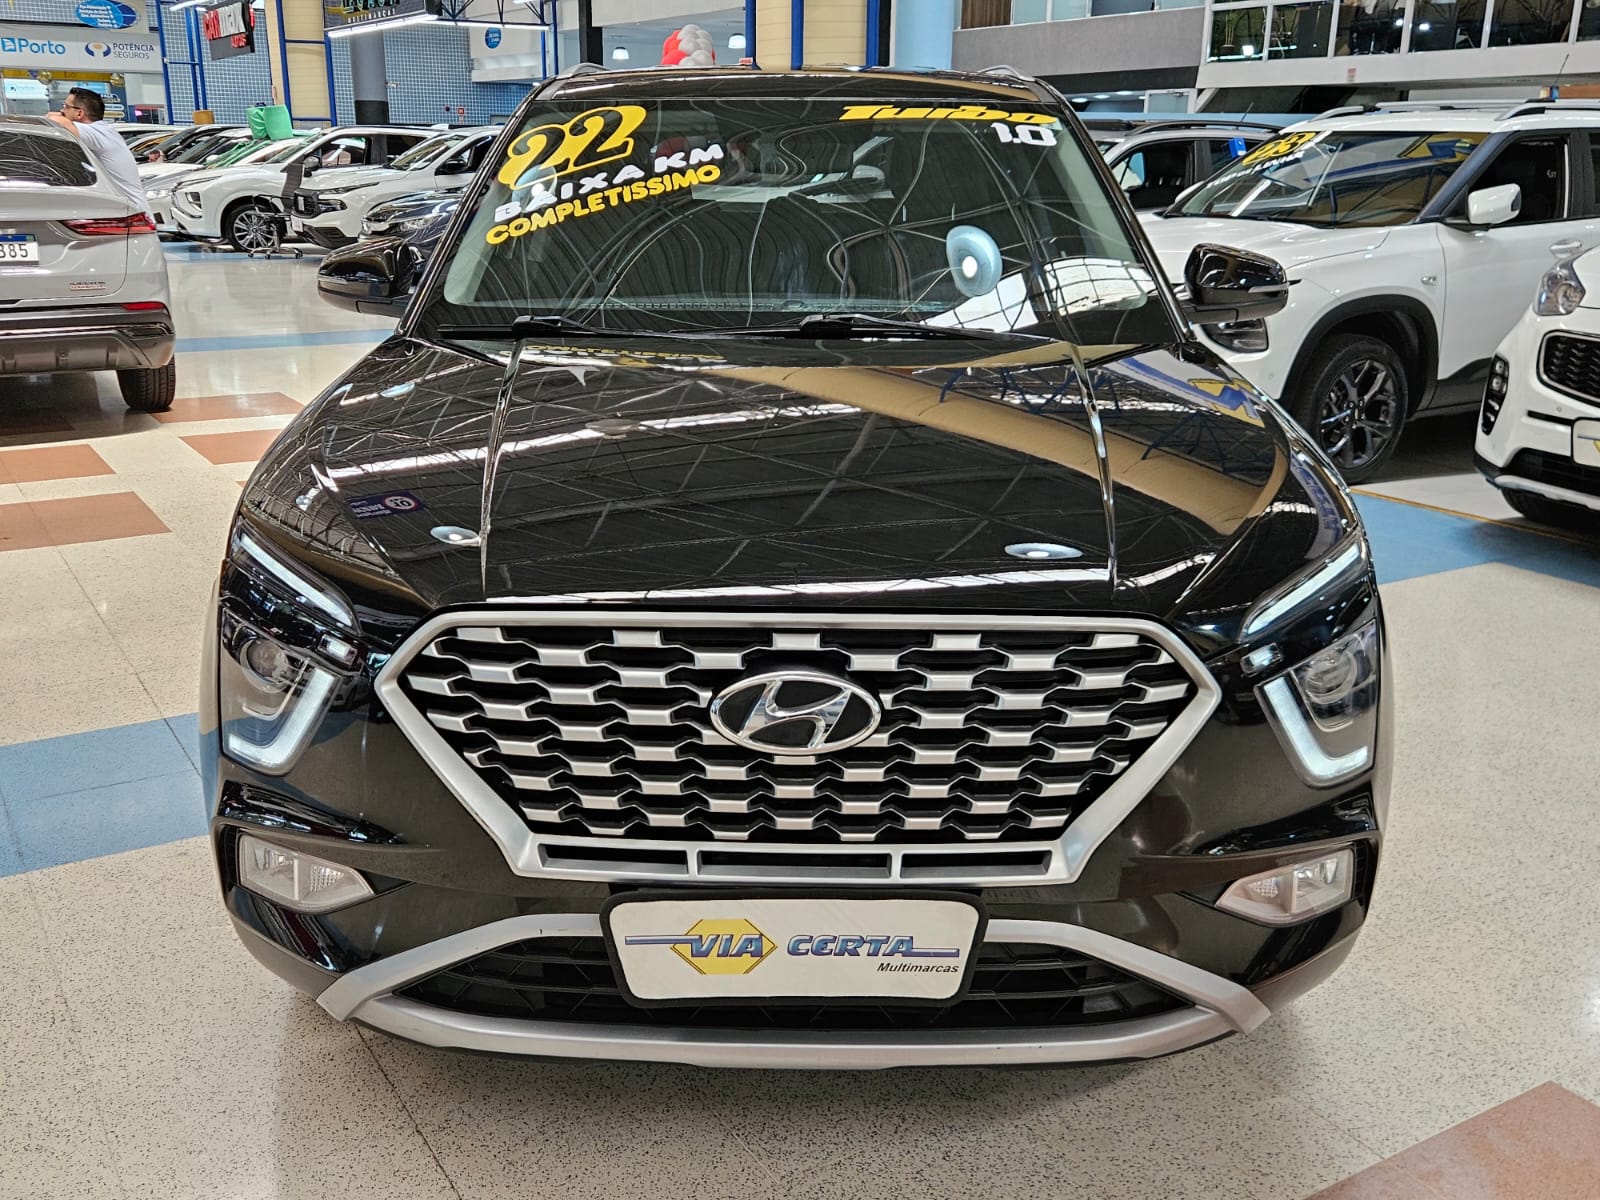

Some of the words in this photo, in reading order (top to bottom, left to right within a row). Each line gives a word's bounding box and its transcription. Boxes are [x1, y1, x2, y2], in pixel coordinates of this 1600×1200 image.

[18, 38, 66, 55] Porto
[113, 51, 150, 59] SEGUROS
[839, 104, 1057, 124] Turbo
[991, 121, 1058, 146] 1.0
[498, 105, 647, 190] 22
[494, 164, 645, 223] BAIXA
[654, 143, 724, 173] KM
[485, 164, 721, 245] COMPLETISSIMO
[690, 934, 764, 957] VIA
[787, 934, 914, 957] CERTA
[877, 961, 960, 974] Multimarcas
